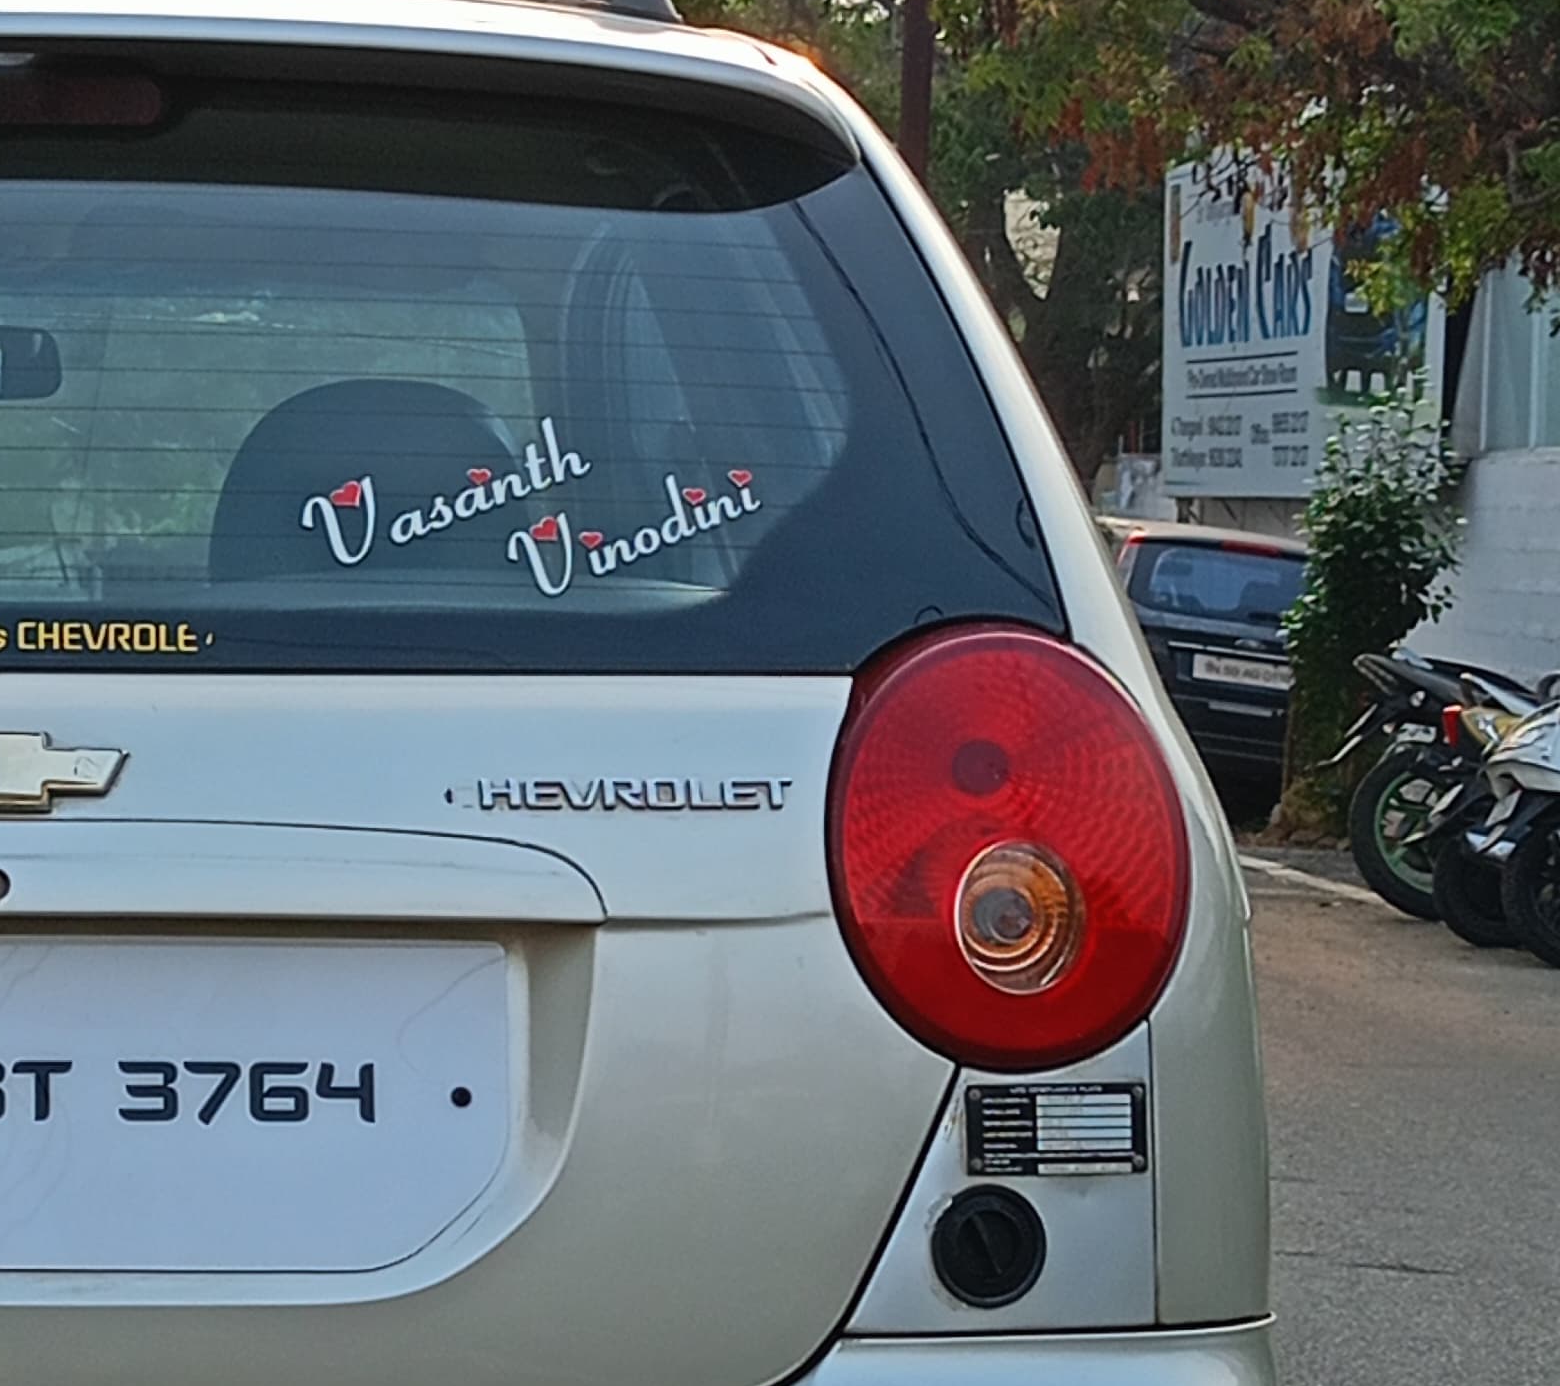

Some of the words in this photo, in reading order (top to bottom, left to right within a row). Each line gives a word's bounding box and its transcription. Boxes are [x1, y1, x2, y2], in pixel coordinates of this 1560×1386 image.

[1179, 240, 1250, 348] GOLDEN
[1256, 223, 1313, 340] CARS
[301, 415, 591, 566] Vasanth
[506, 469, 762, 596] Vinodini
[17, 621, 214, 653] CHEVROLE
[117, 1060, 376, 1125] 3764
